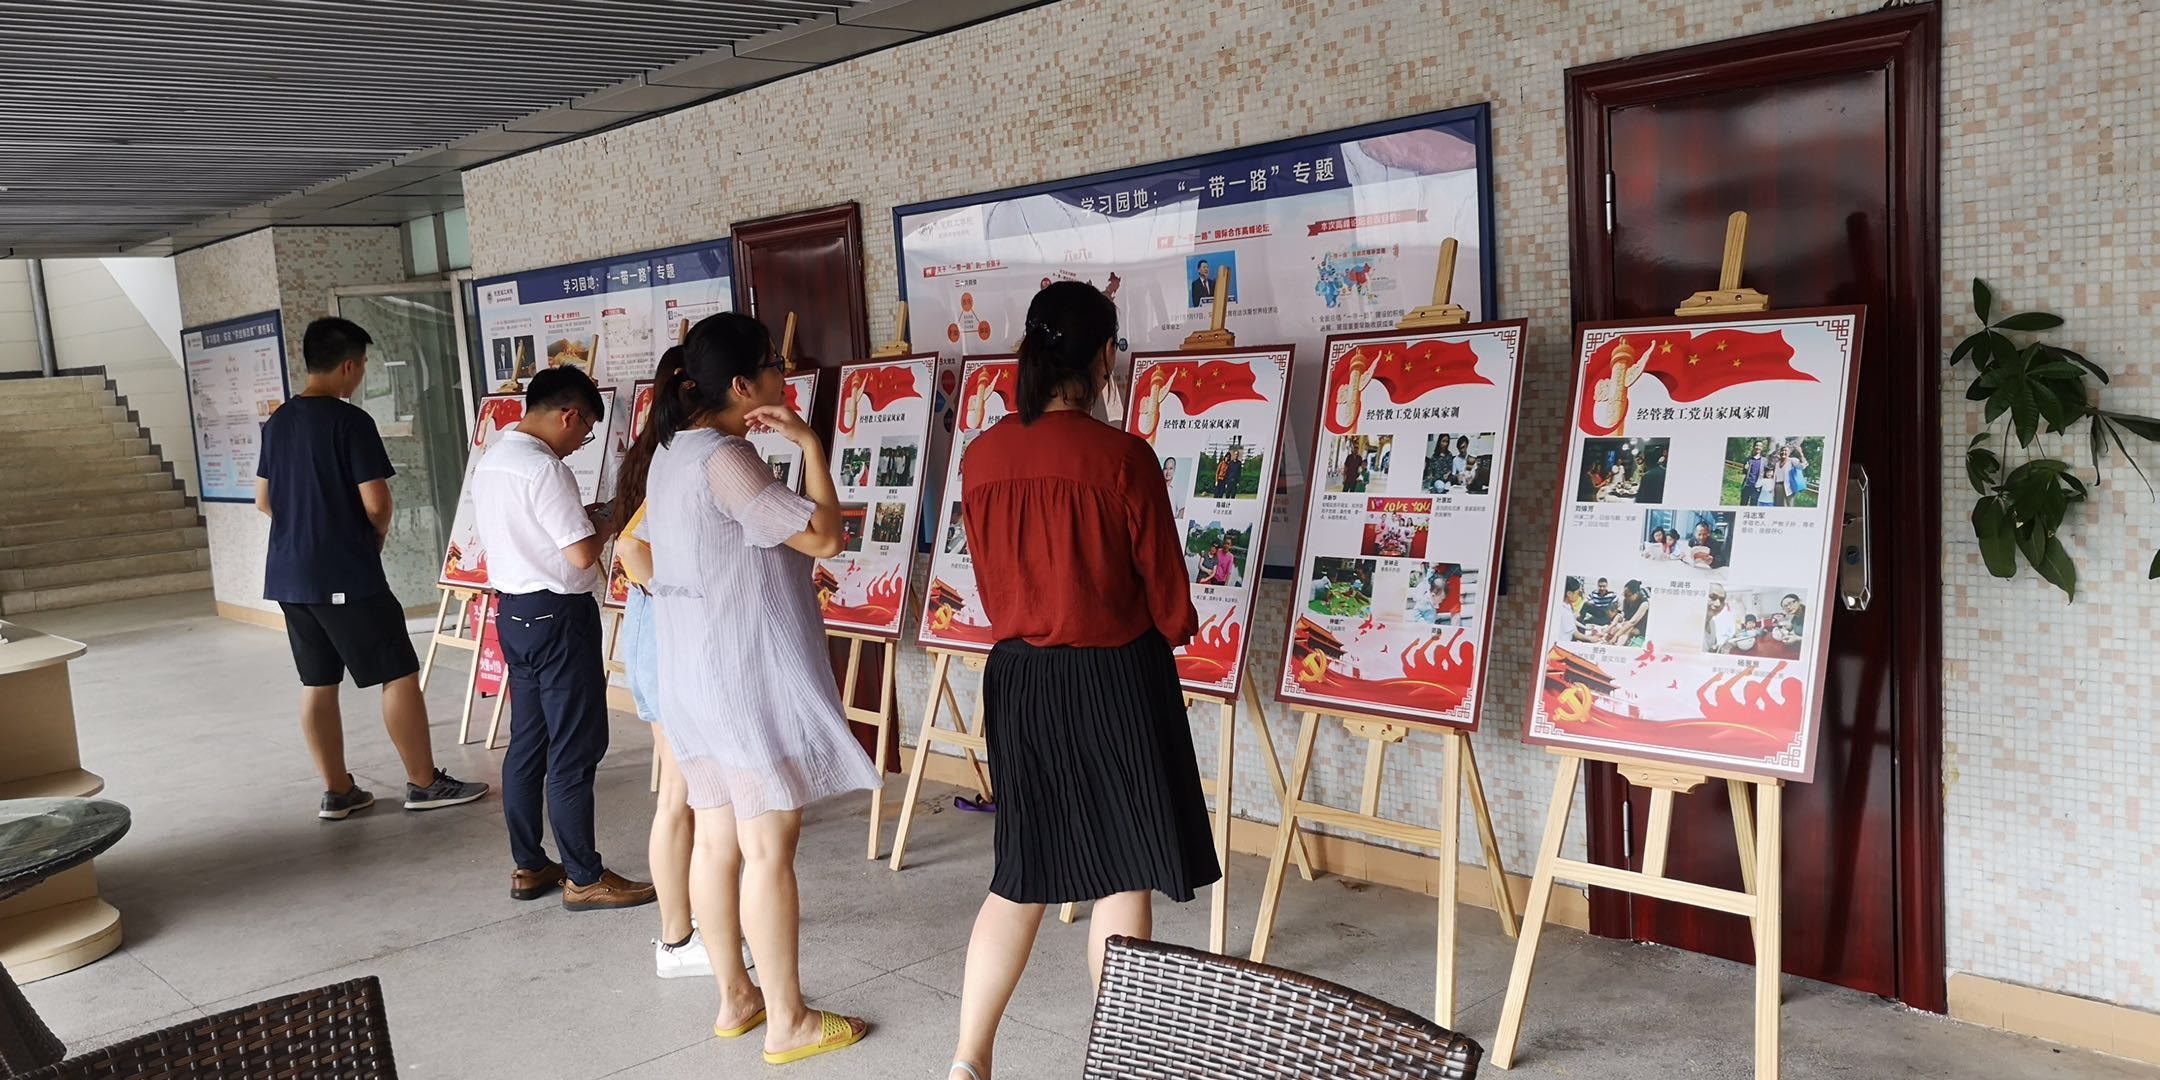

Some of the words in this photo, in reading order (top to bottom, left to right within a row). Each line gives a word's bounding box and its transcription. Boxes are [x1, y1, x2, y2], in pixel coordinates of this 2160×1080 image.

[1366, 406, 1460, 421] 经管教工党员家风家训
[1636, 406, 1770, 421] 经管教工党员家风家训
[1163, 419, 1241, 430] 经管教工党员家风家训
[1383, 500, 1409, 512] LOVE
[1410, 500, 1431, 512] YOU
